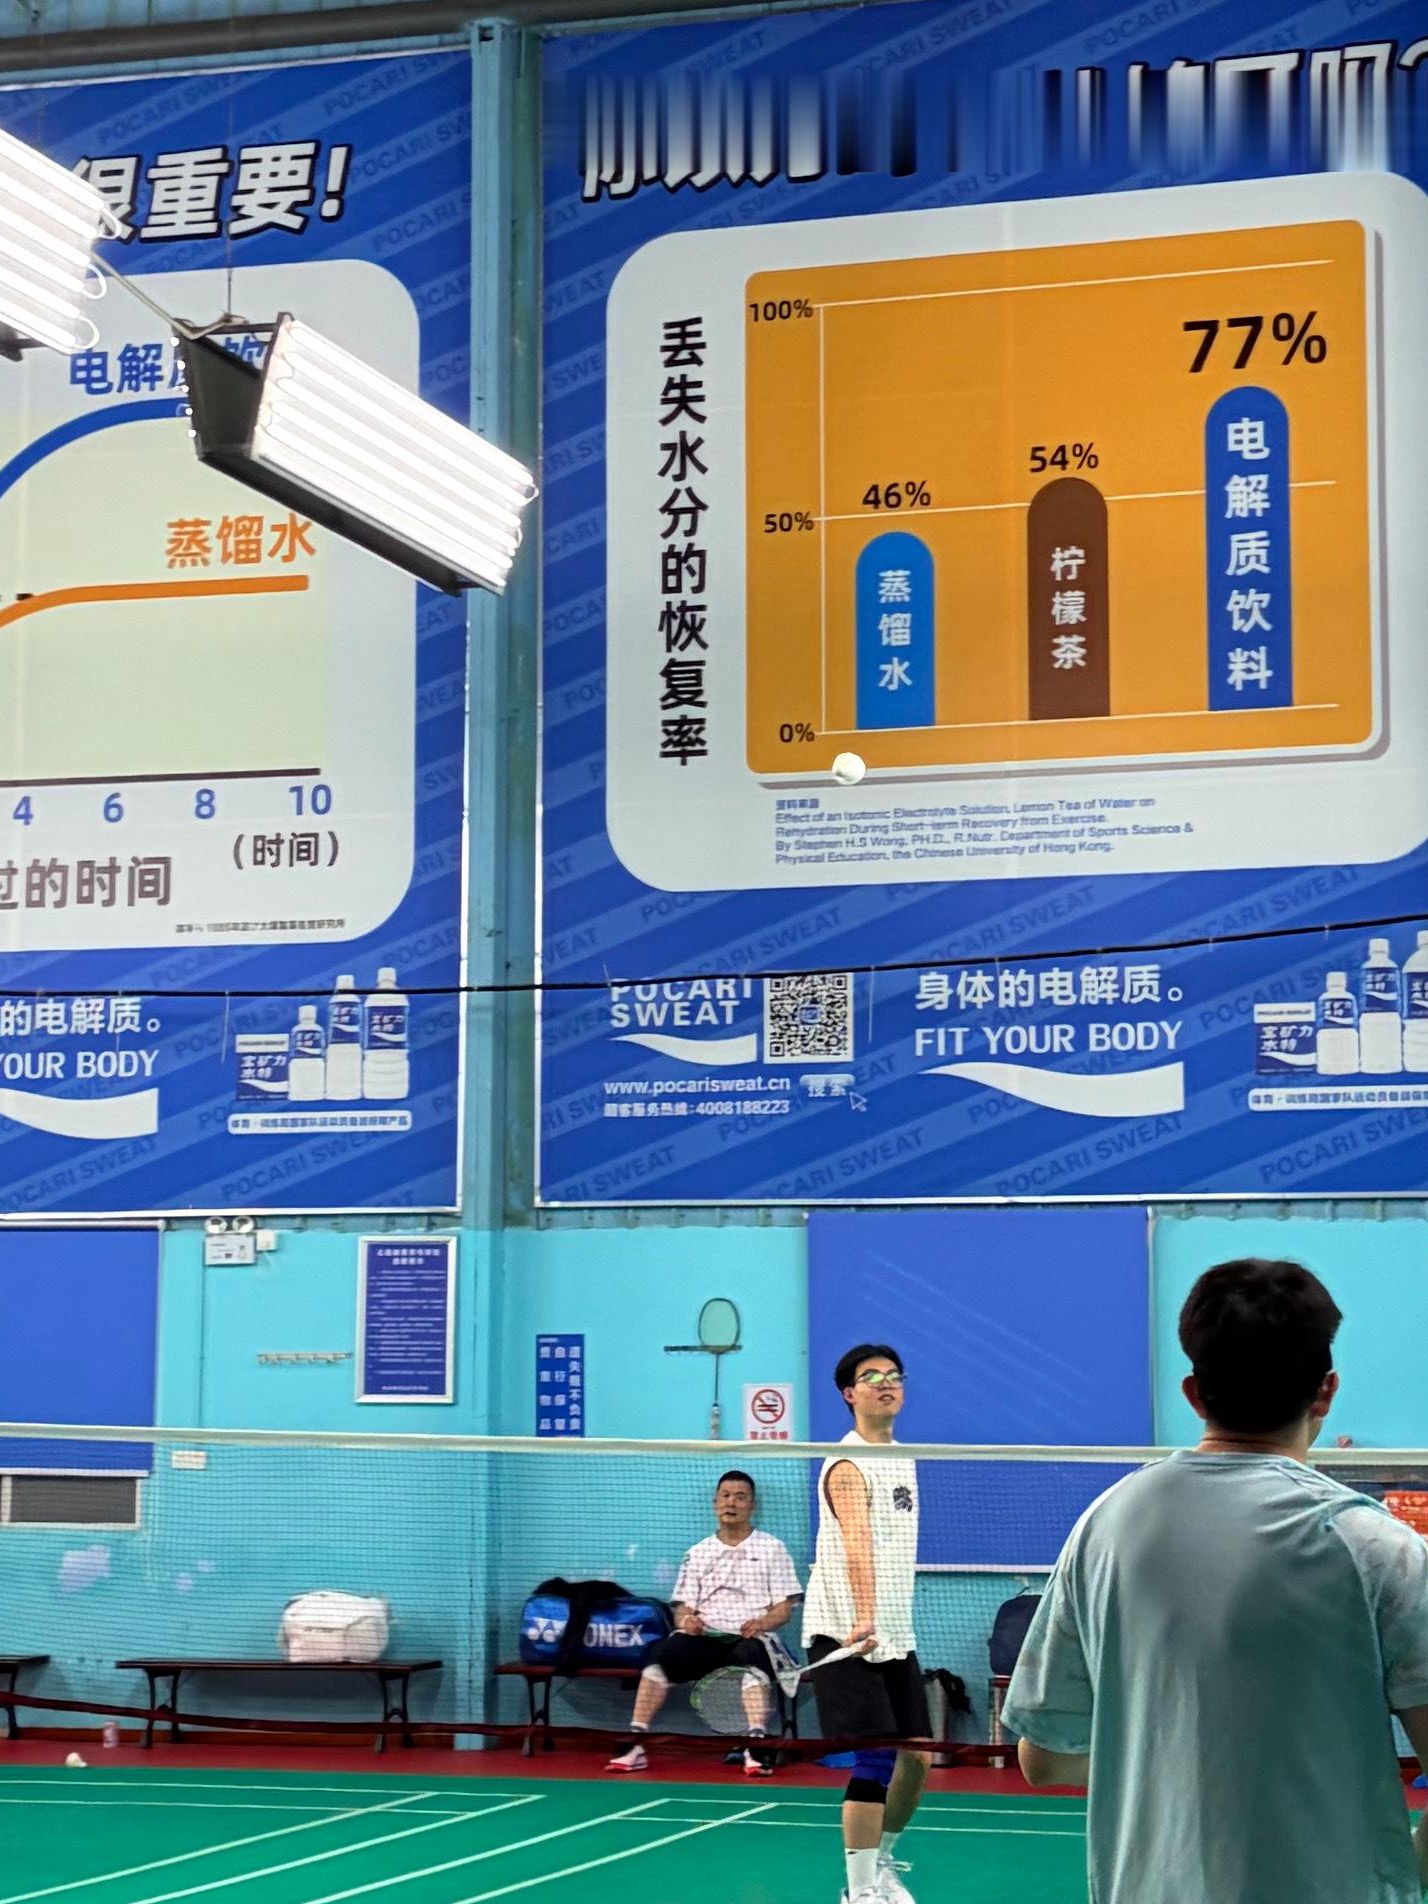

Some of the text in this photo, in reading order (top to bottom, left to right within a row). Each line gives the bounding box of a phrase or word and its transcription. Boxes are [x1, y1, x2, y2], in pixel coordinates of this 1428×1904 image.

[374, 200, 457, 253] POCARI
[748, 299, 814, 323] 100%
[1183, 311, 1328, 374] 77%
[1029, 442, 1100, 473] 54%
[862, 480, 932, 510] 46%
[763, 511, 815, 533] 50%
[165, 512, 316, 569] 蒸馏水
[657, 315, 709, 767] 丢失水分的恢复率
[1223, 416, 1275, 692] 电解质饮料
[1049, 546, 1088, 670] 柠檬茶
[877, 569, 914, 692] 蒸馏水
[778, 722, 816, 744] 0%
[12, 795, 34, 826] 4
[103, 792, 124, 823] 6
[194, 788, 216, 819] 8
[288, 784, 332, 816] 10
[775, 812, 810, 824] Effect
[233, 830, 340, 870] (时间)
[759, 907, 842, 956] SWEAT
[610, 977, 753, 1002] POCARI
[914, 964, 1185, 1011] 身体的电解质。
[610, 1000, 741, 1028] SWEAT
[914, 1021, 1184, 1057] FIT YOUR BODY
[76, 1049, 160, 1078] BODY
[603, 1075, 791, 1097] www.pocarisweat.cn
[839, 1128, 924, 1180] SWEAT
[1257, 1128, 1362, 1185] POCARI
[222, 1152, 310, 1200] POCARI
[583, 1623, 645, 1649] ONEX
